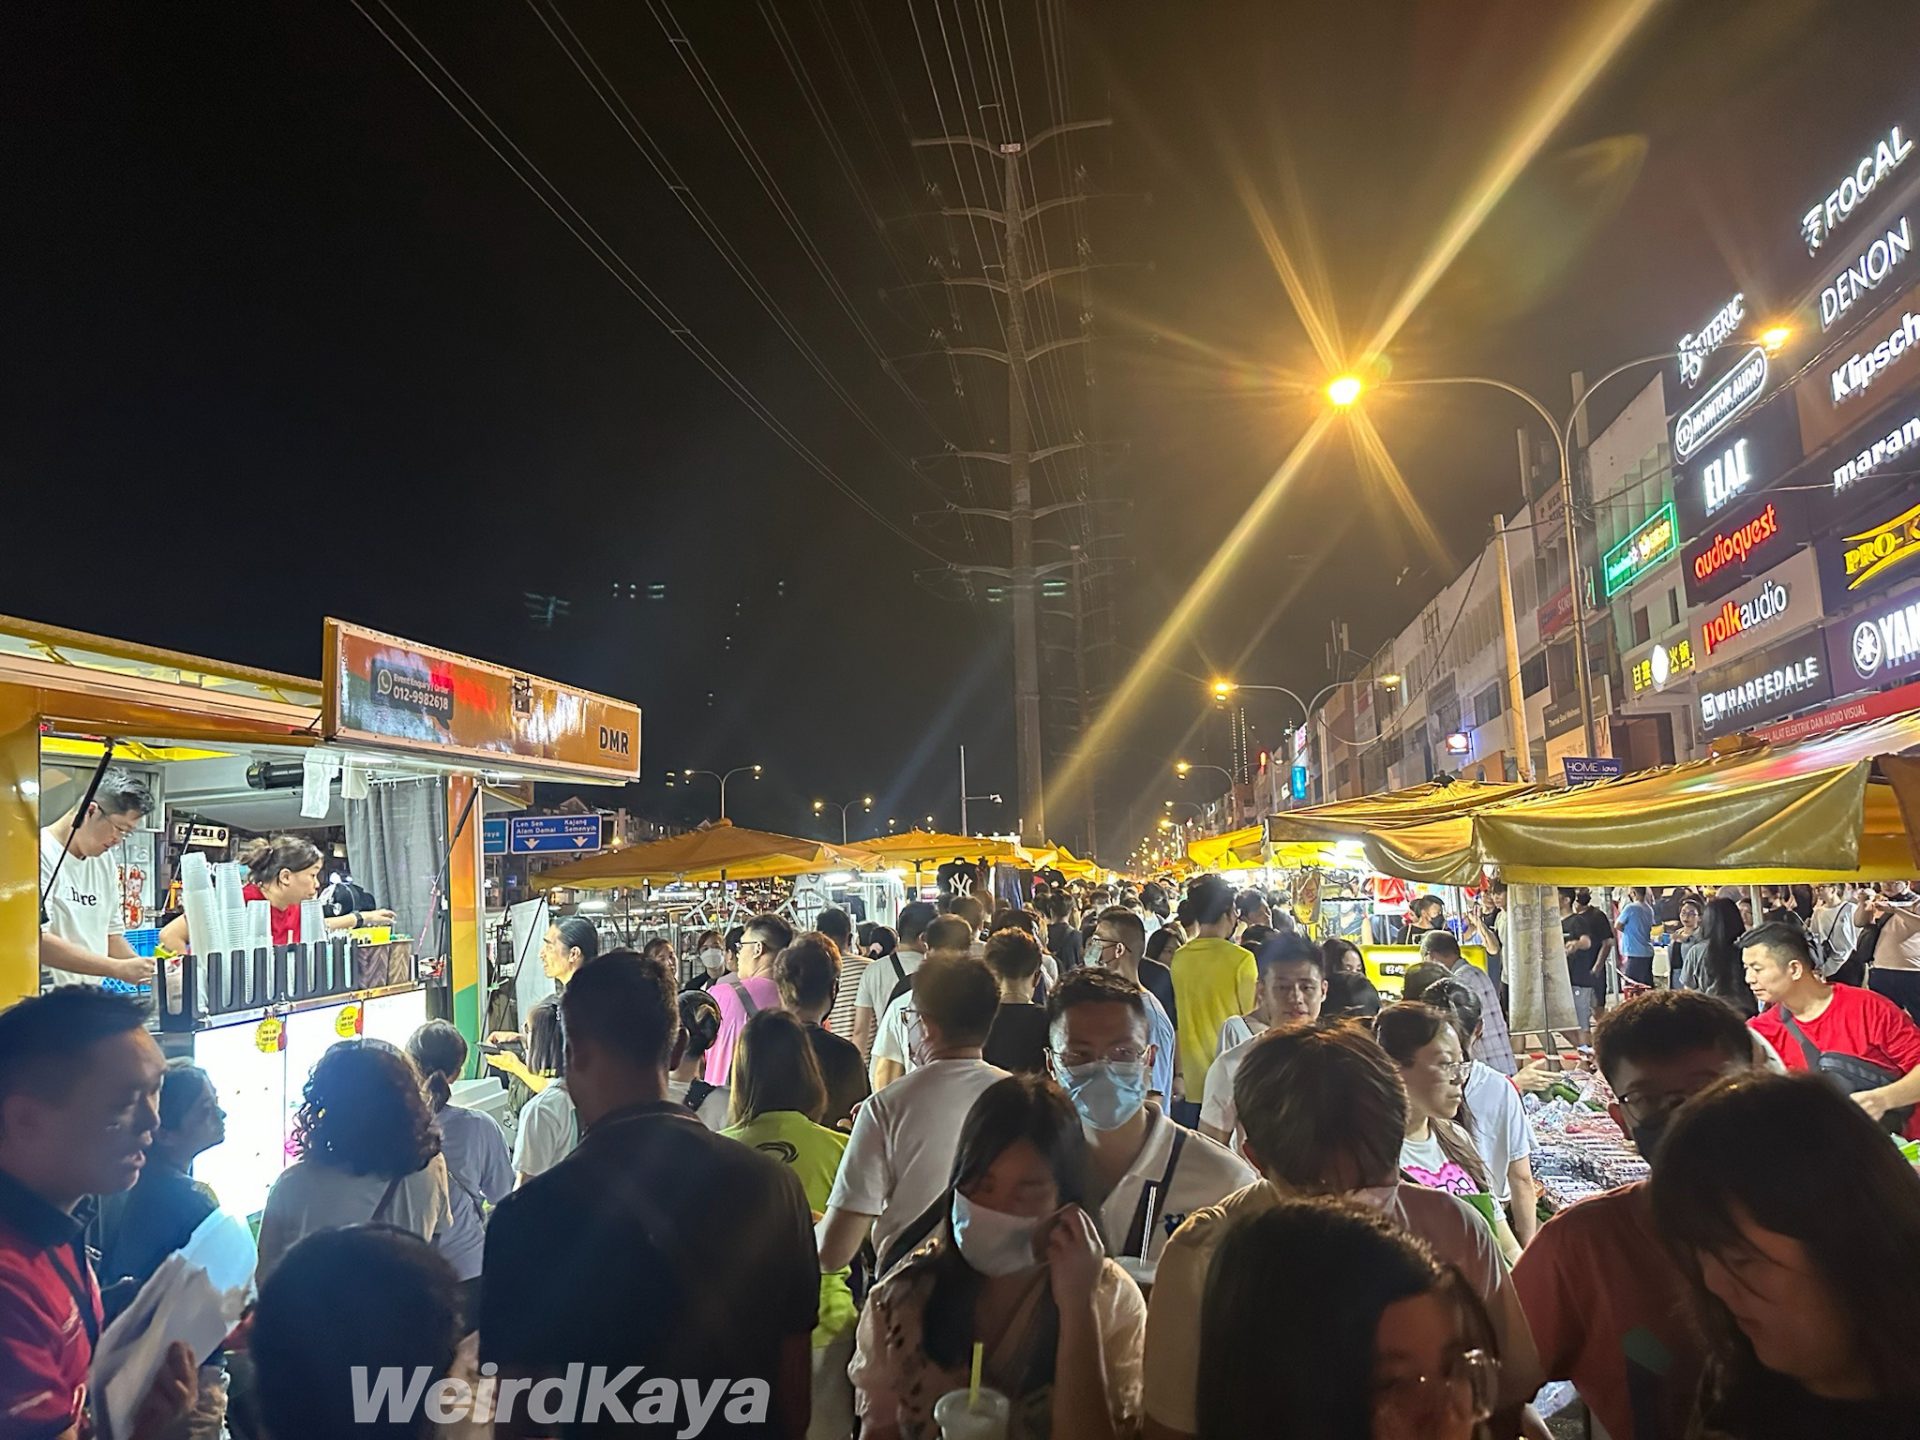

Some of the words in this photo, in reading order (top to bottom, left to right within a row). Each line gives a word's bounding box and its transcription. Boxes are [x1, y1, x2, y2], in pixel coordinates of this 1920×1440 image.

[1825, 126, 1913, 229] FOCAL
[1822, 216, 1911, 325] DENON
[1831, 312, 1920, 402] Klipsch
[1694, 504, 1777, 579] audioquest
[1712, 656, 1819, 711] WHARFEDALE
[1824, 710, 1844, 726] AUDIO
[1843, 704, 1867, 720] VISUAL
[600, 726, 629, 754] DMR
[1566, 762, 1599, 772] HOME
[516, 827, 534, 835] Alam
[535, 826, 557, 834] Damai
[564, 819, 587, 827] Kajang
[564, 825, 597, 833] Semenyih
